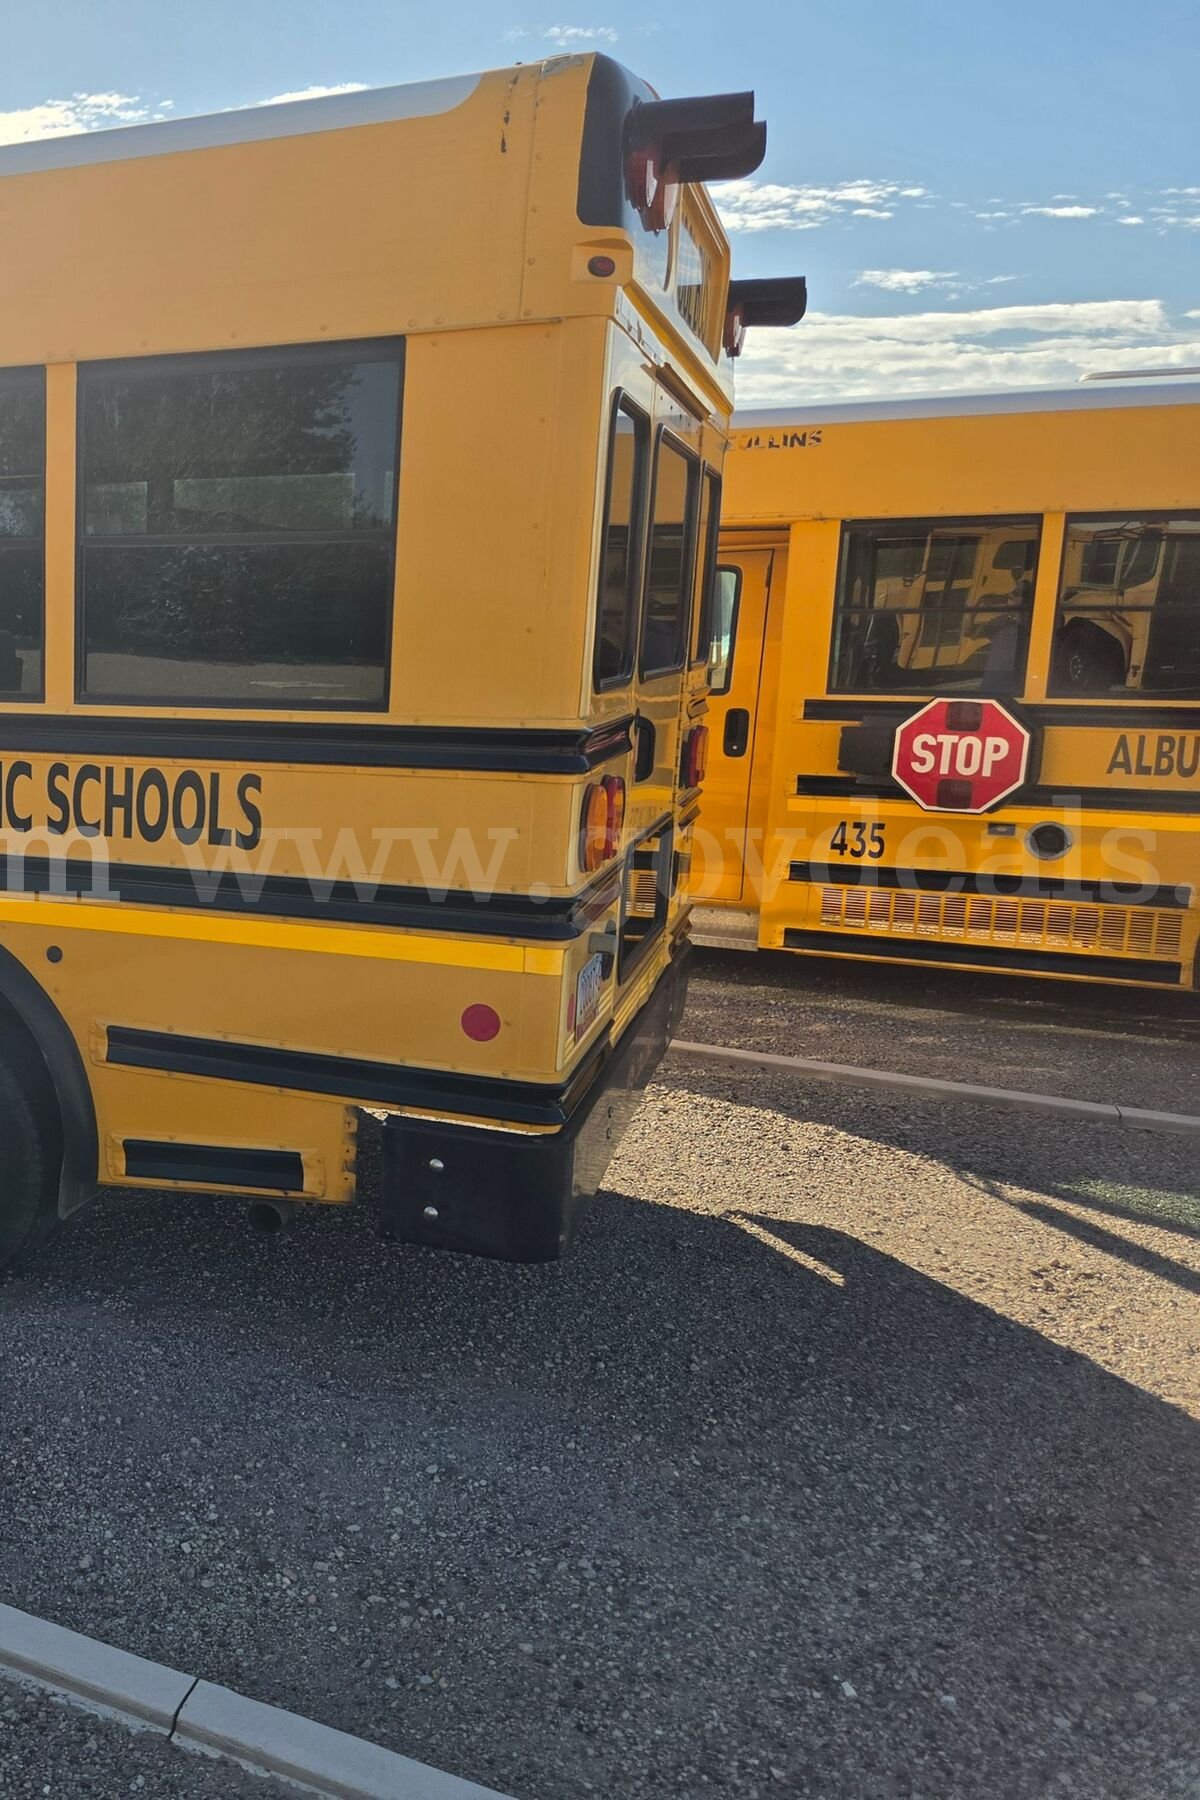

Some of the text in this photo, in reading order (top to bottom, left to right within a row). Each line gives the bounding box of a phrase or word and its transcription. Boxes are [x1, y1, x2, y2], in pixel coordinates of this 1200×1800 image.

[728, 429, 823, 451] LLINS
[910, 733, 1010, 777] STOP
[1105, 733, 1200, 778] ALBU
[45, 761, 263, 852] SCHOOLS
[829, 820, 886, 859] 435
